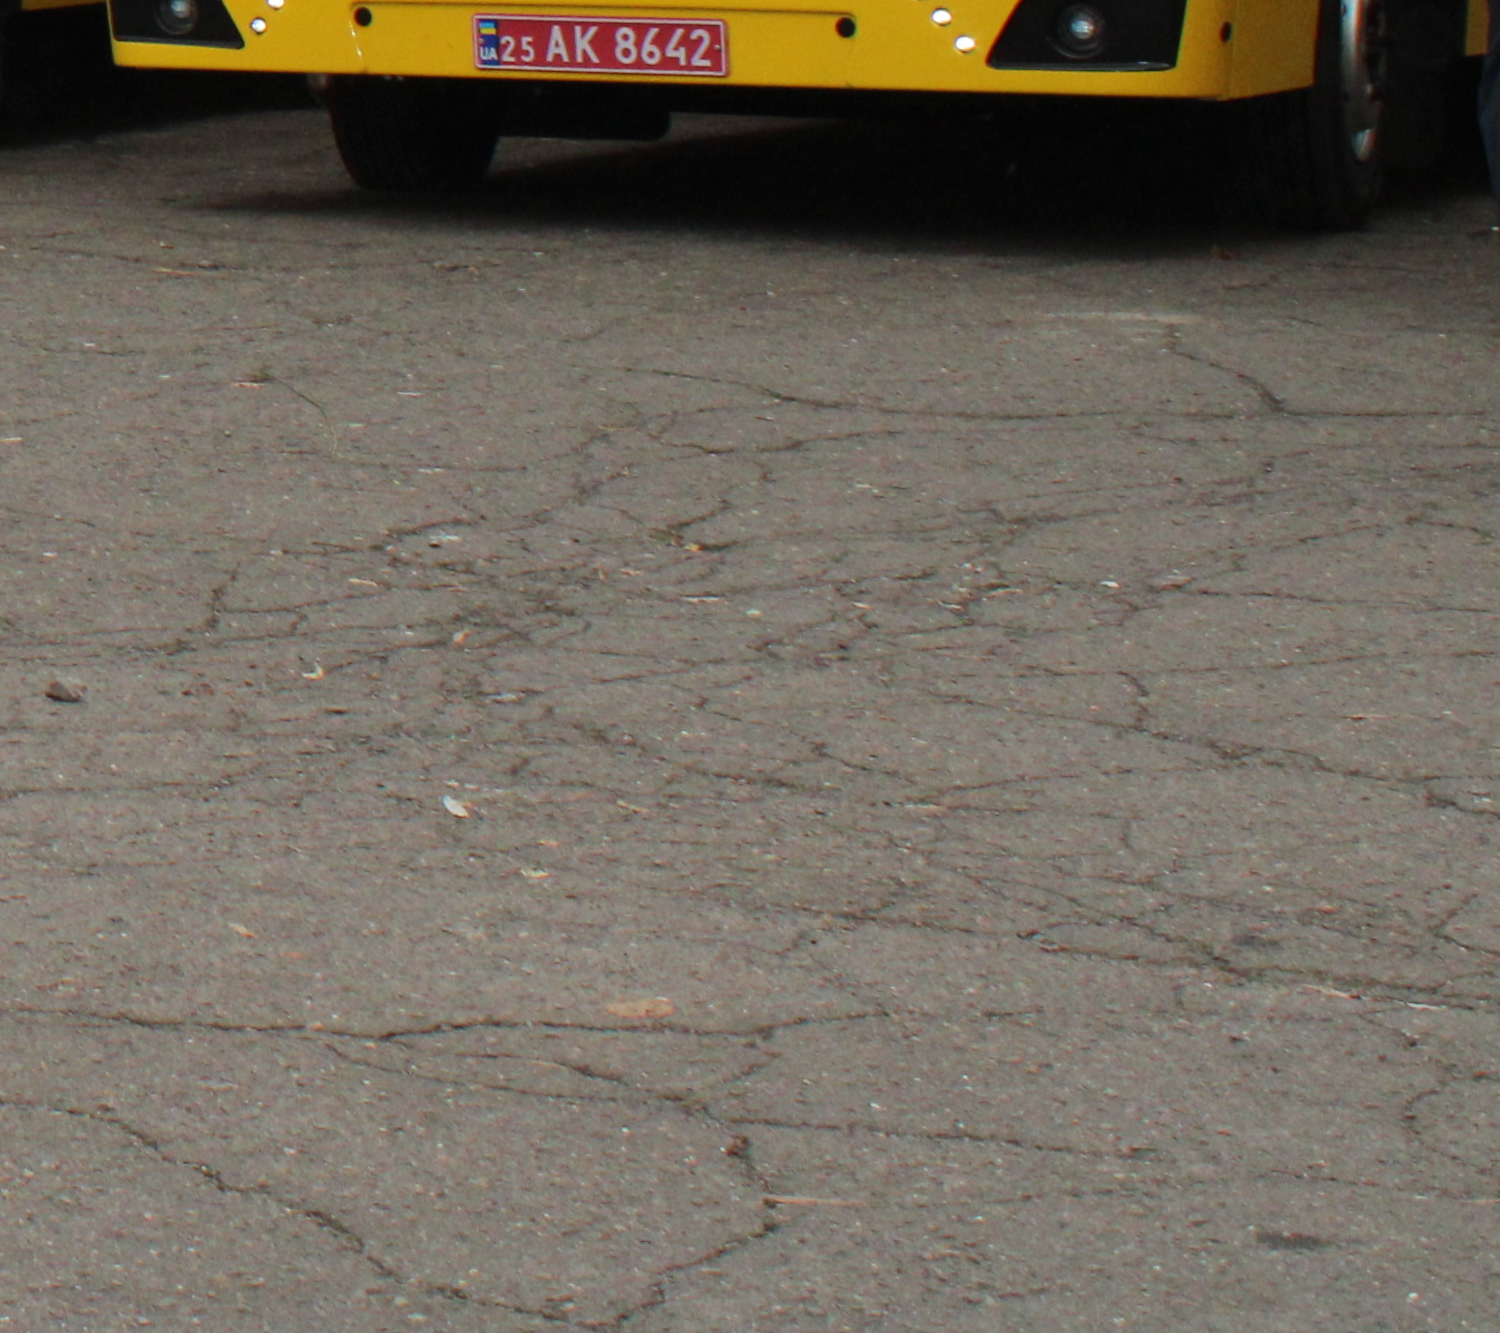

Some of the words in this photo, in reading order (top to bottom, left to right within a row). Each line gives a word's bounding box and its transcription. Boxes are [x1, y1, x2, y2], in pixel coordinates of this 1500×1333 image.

[479, 46, 498, 61] UA
[500, 35, 536, 62] 25
[546, 24, 600, 64] AK
[614, 26, 712, 67] 8642
